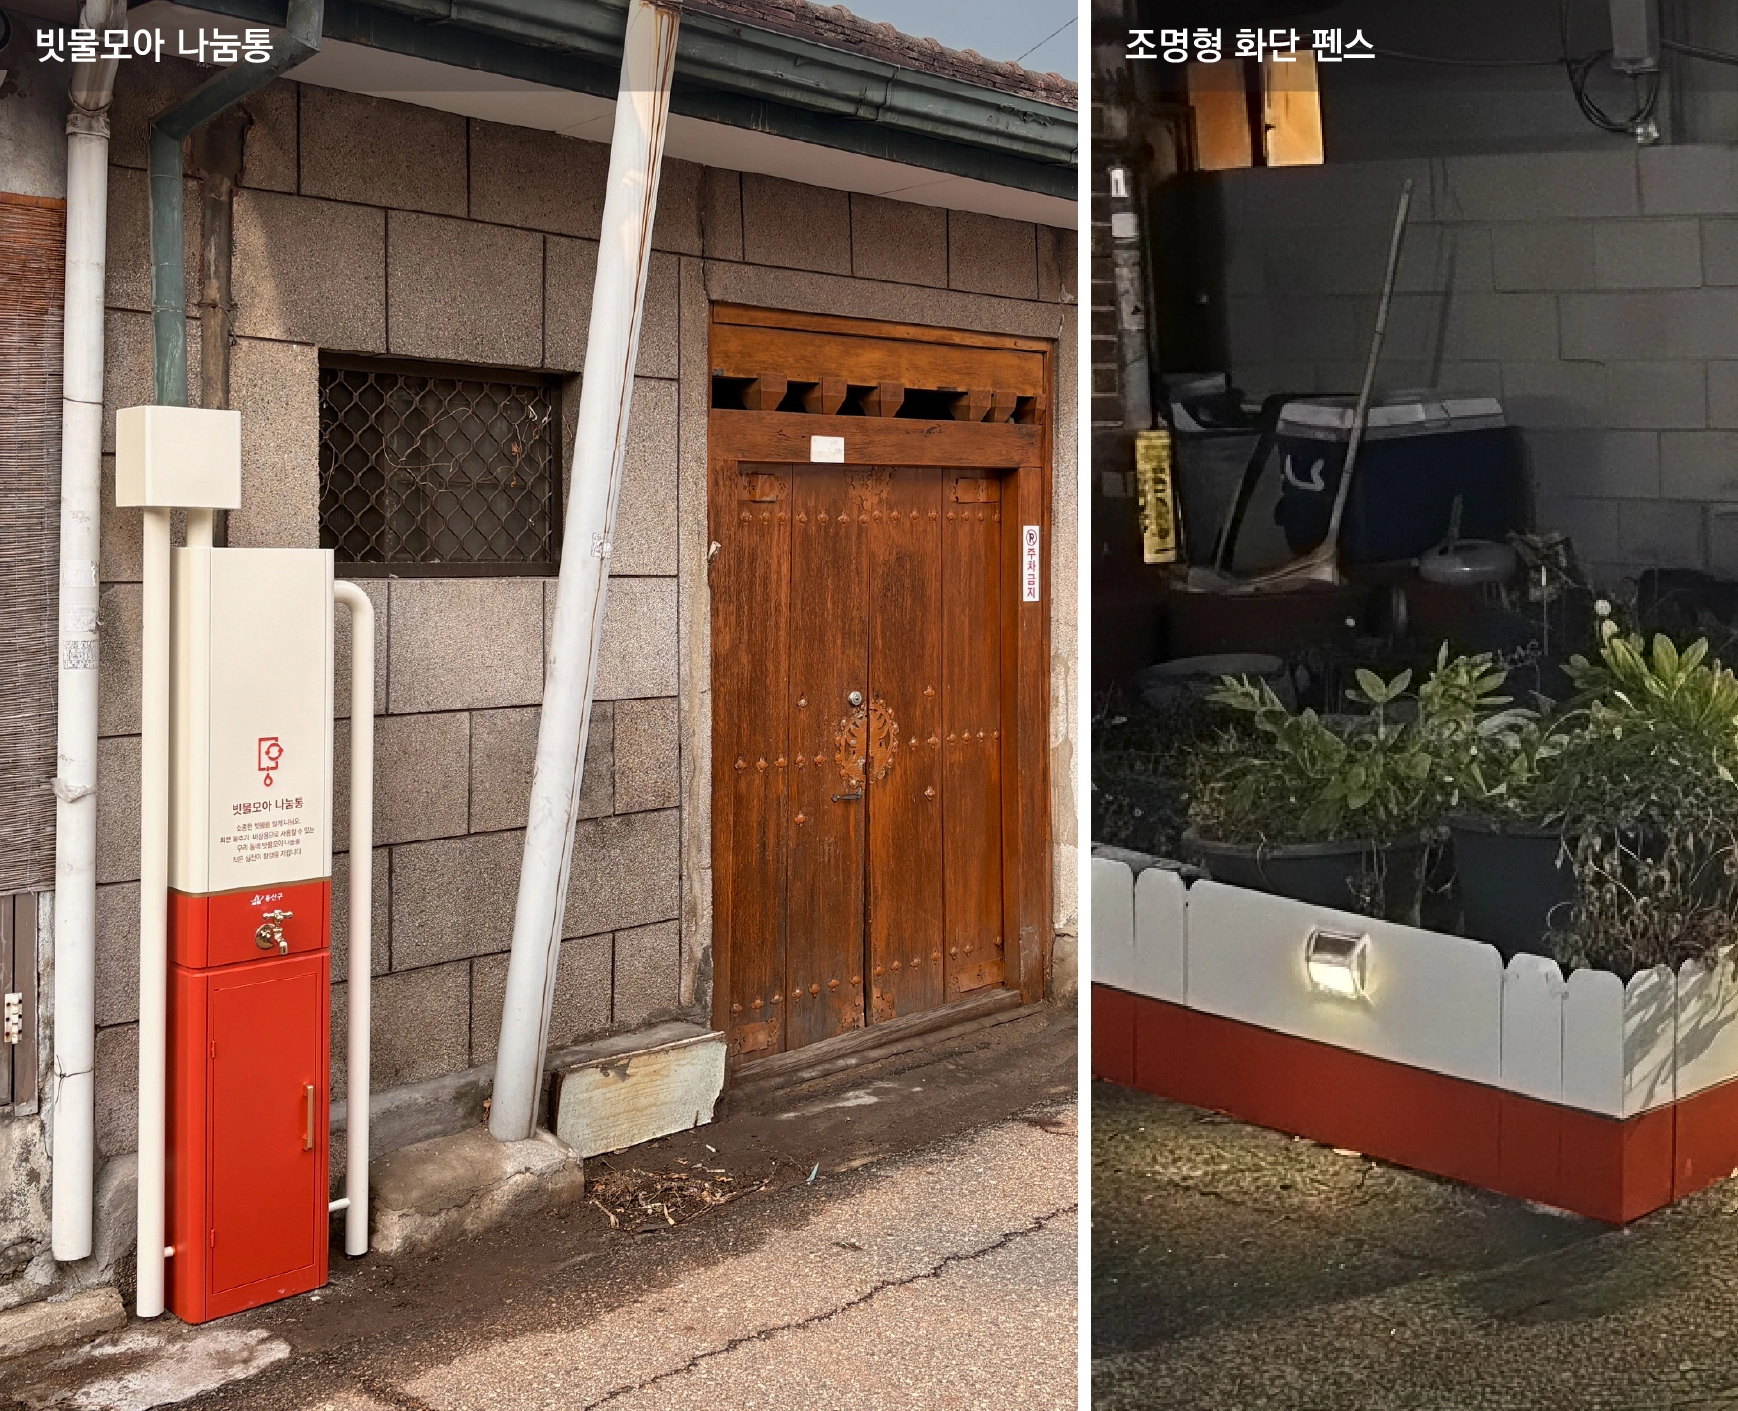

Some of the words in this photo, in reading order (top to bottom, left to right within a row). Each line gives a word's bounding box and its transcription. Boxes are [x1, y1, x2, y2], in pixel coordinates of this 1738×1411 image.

[1027, 548, 1037, 599] 주차금지
[232, 800, 272, 816] 빗물모아
[275, 796, 304, 811] 나눔통
[265, 892, 284, 903] 용산구
